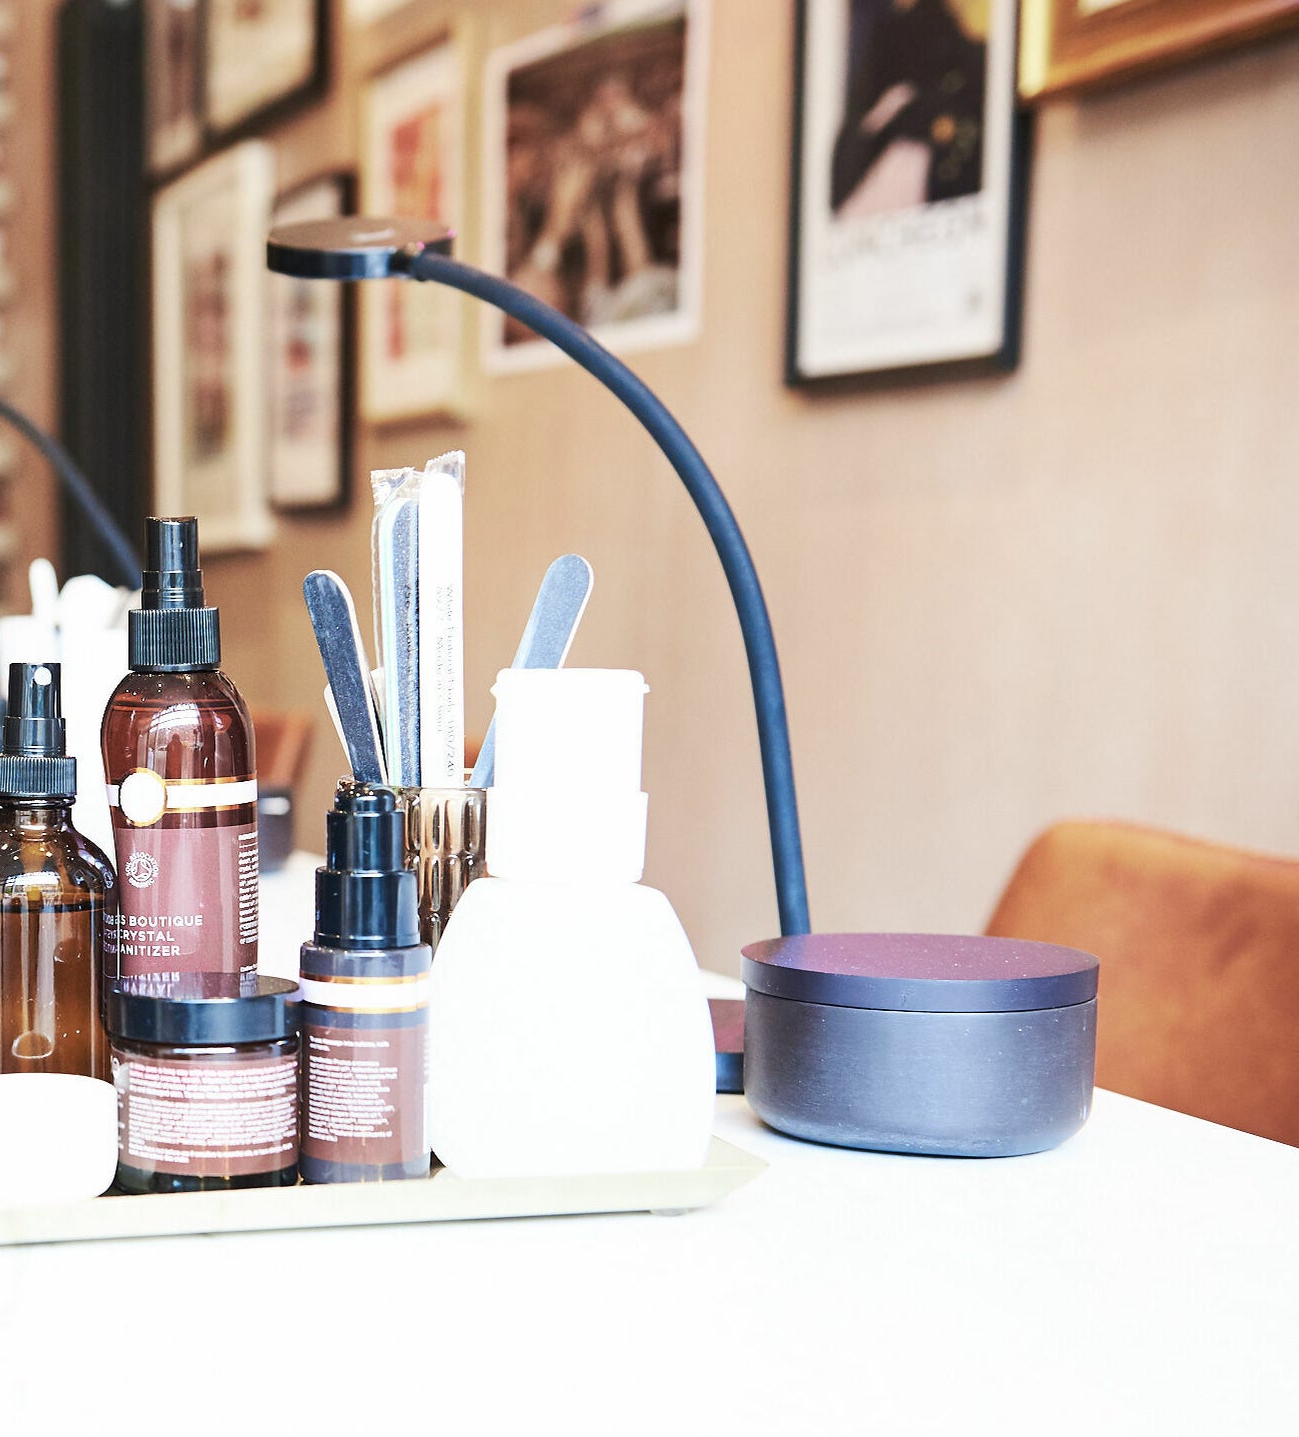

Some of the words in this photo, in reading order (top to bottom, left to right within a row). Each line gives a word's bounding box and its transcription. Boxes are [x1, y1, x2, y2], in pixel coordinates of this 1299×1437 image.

[129, 914, 203, 927] BOUTIQUE
[119, 929, 175, 942] CRYSTAL
[117, 943, 180, 957] ANITIZER
